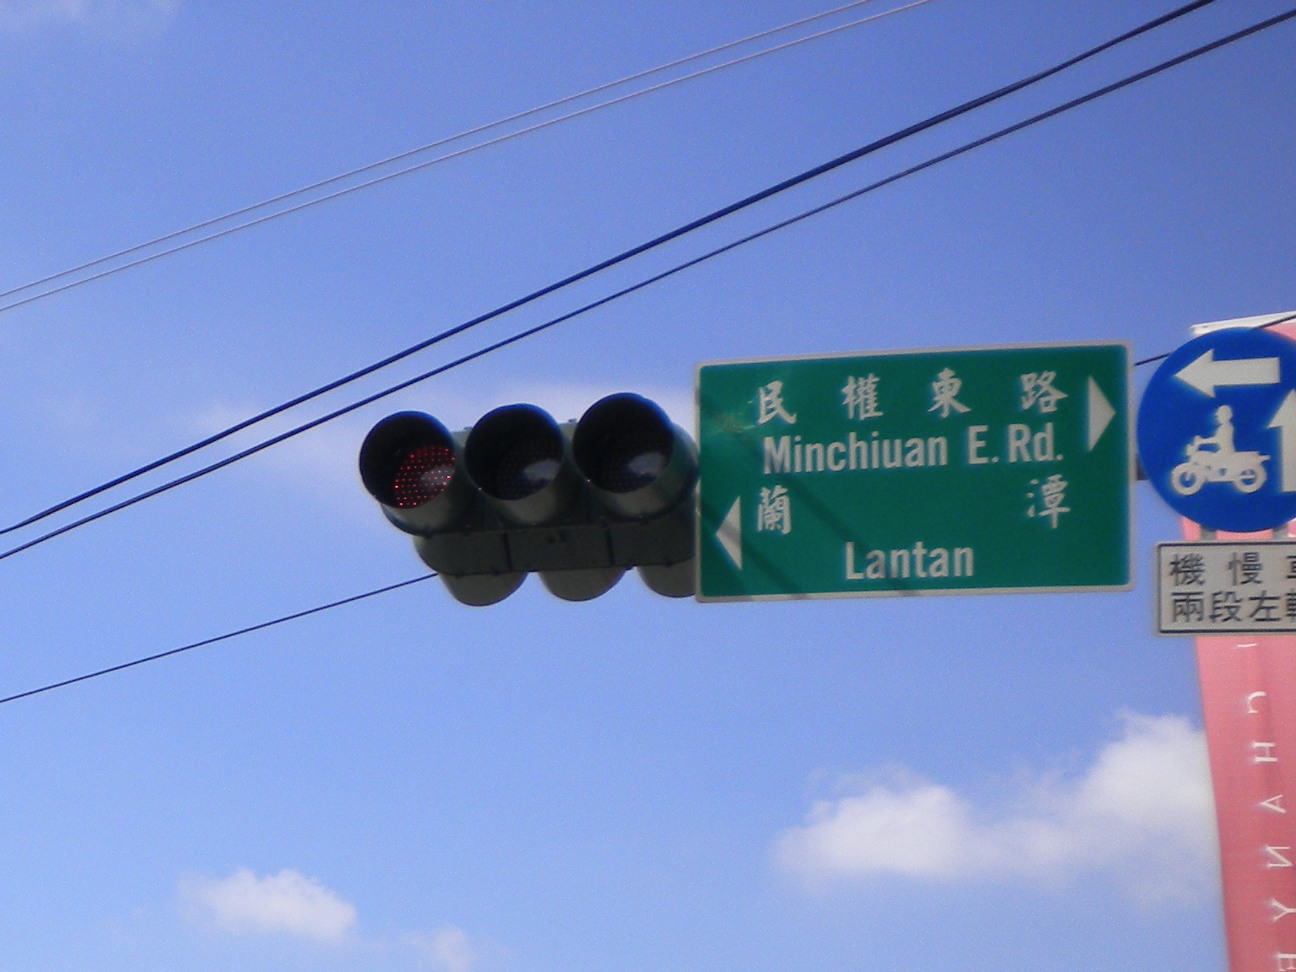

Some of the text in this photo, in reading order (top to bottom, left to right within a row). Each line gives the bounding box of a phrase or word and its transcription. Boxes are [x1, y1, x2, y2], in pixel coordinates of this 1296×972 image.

[757, 367, 1069, 425] 民權東路
[762, 422, 1064, 475] Minchiuan E. Rd.
[845, 541, 974, 580] Lantan
